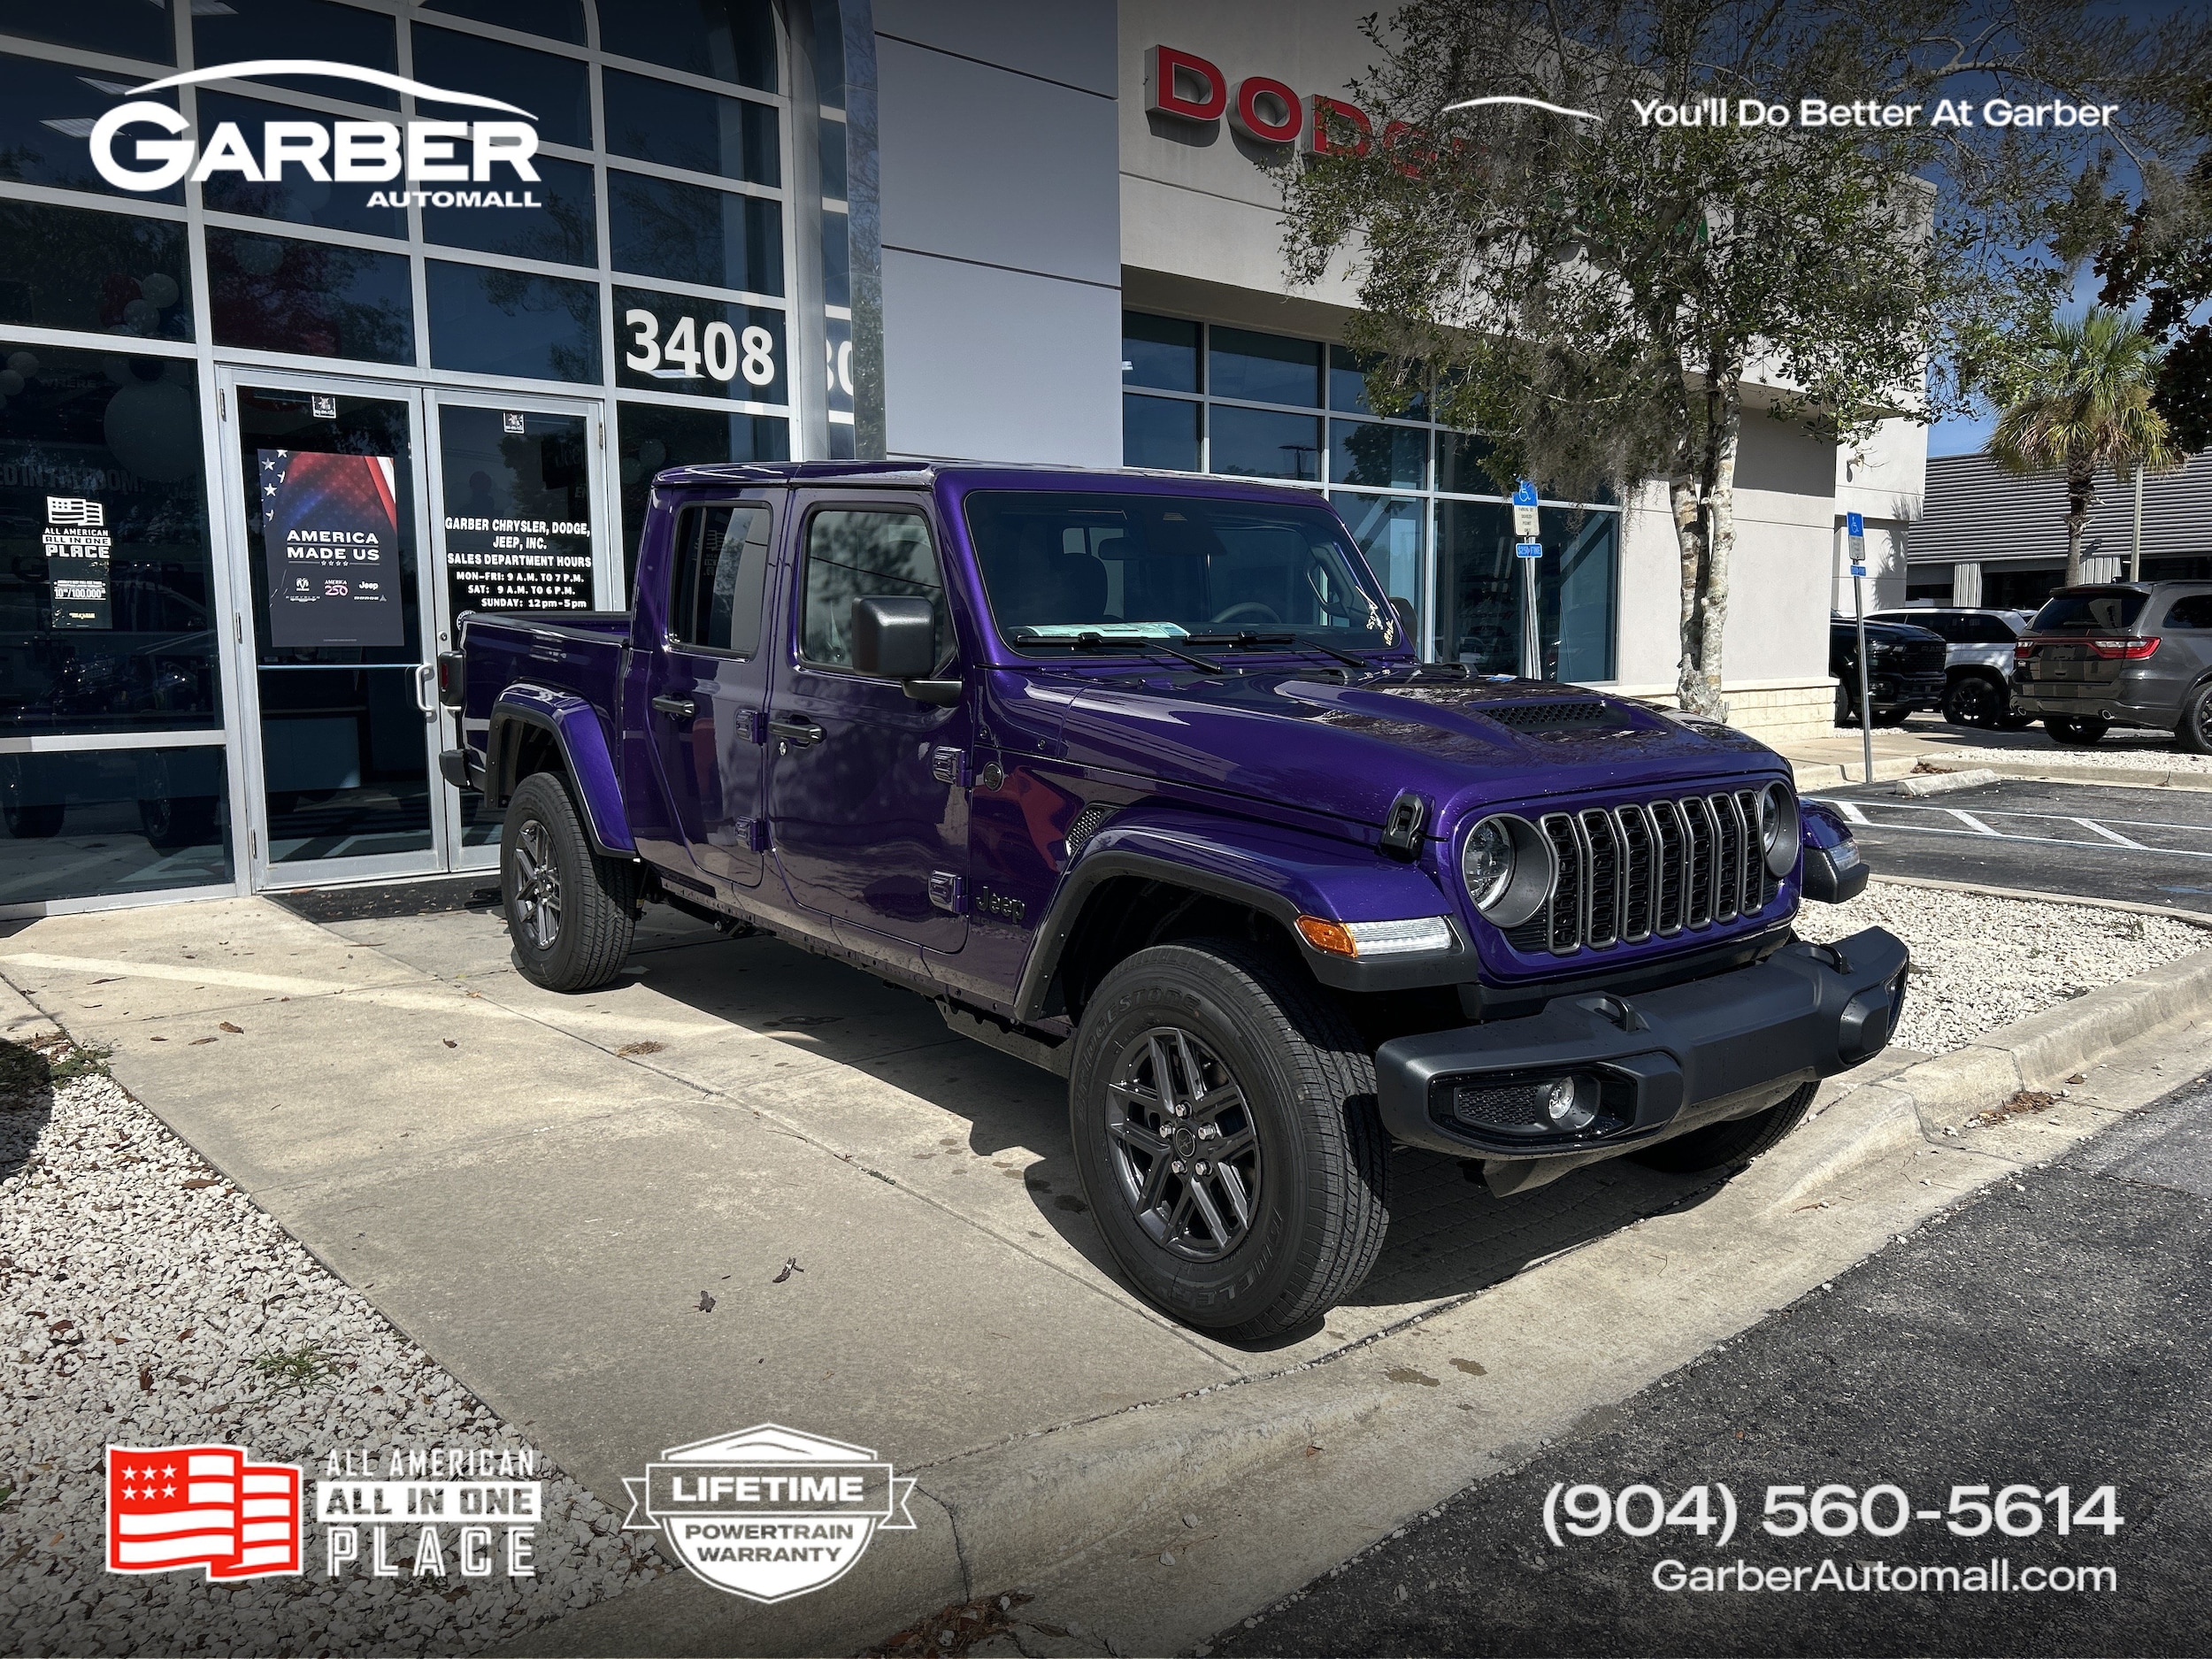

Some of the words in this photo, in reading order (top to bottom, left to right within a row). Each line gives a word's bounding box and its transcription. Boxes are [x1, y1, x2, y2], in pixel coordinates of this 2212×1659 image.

[1145, 44, 1488, 181] DODG
[626, 308, 775, 386] 3408
[445, 517, 489, 531] GARBER
[492, 518, 550, 536] CHRYSLER,
[552, 521, 591, 537] DODGE,
[287, 529, 379, 544] AMERICA
[492, 536, 523, 551] JEEP,
[526, 537, 547, 549] INC.
[45, 545, 111, 559] PLACE
[287, 547, 347, 560] MADE
[353, 548, 380, 561] US
[447, 553, 482, 565] SALES
[484, 554, 554, 567] DEPARTMENT
[557, 556, 592, 568] HOURS
[456, 571, 504, 581] MON-FRI:
[507, 572, 513, 581] 9
[517, 572, 538, 582] A.M.
[541, 573, 553, 582] TO
[555, 573, 561, 582] 7
[564, 573, 584, 582] P.M.
[358, 580, 379, 591] Jeep
[467, 585, 490, 595] SAT:
[497, 586, 503, 595] 9
[506, 586, 528, 595] A.M.
[531, 586, 543, 595] TO
[546, 586, 552, 595] 6
[554, 586, 576, 595] P.M.
[481, 597, 524, 608] SUNDAY:
[975, 886, 1025, 925] Jeep
